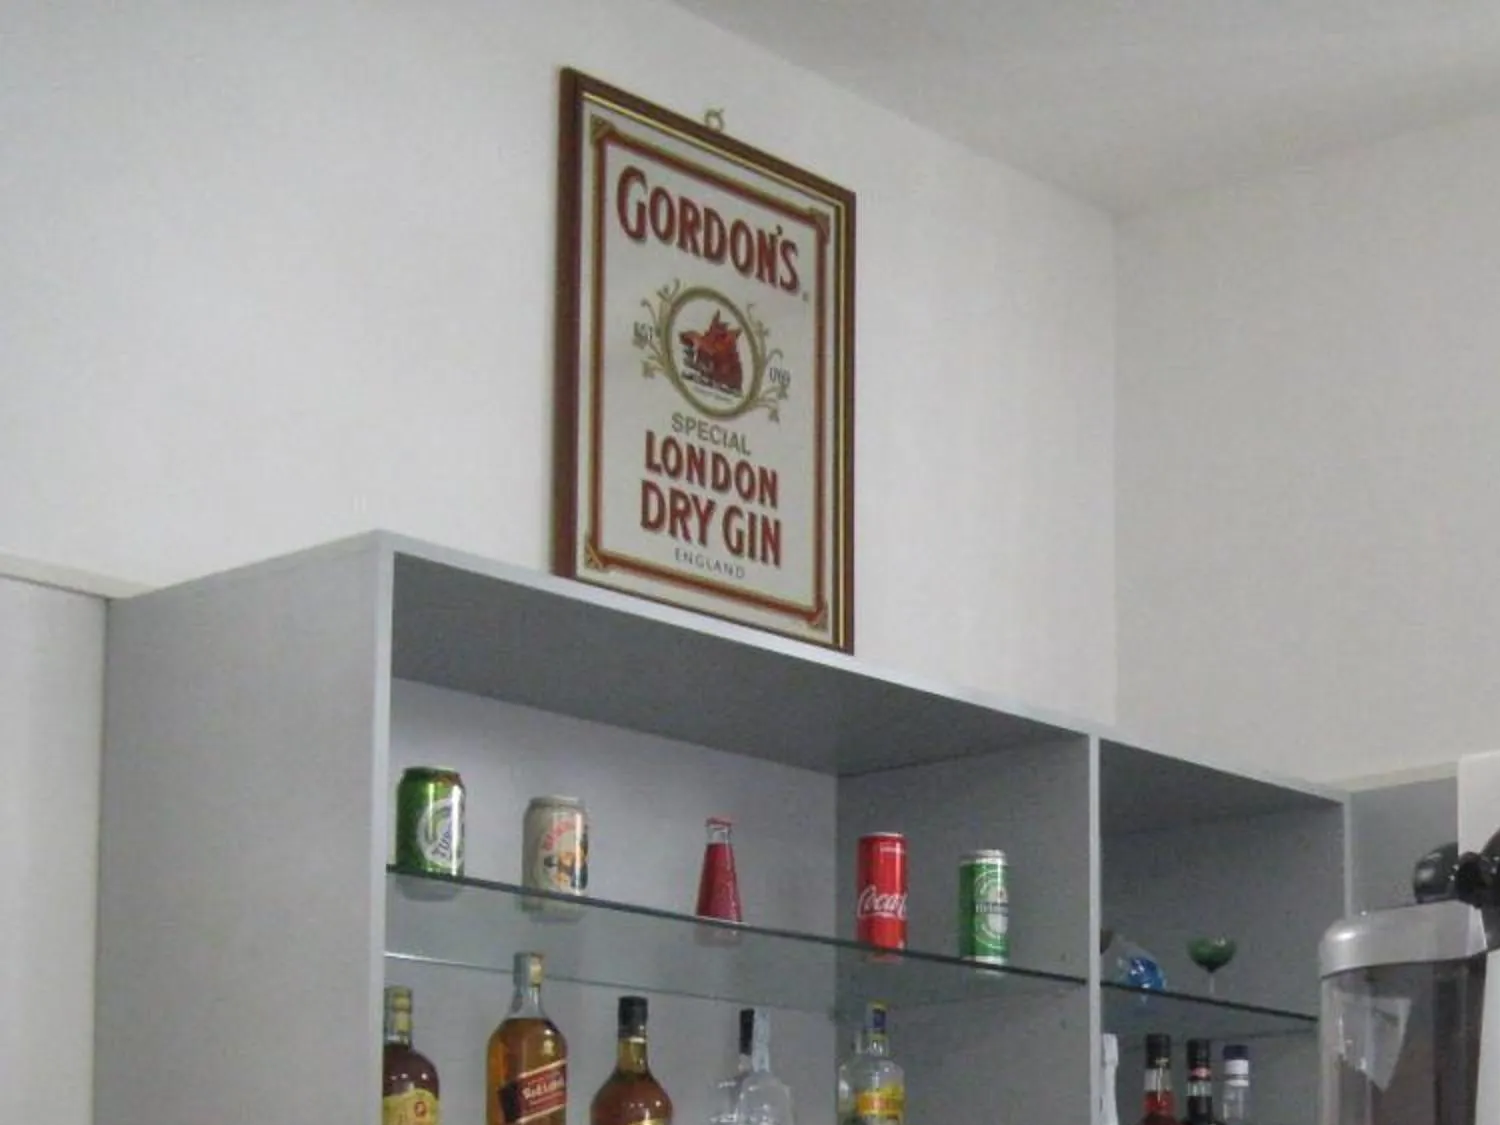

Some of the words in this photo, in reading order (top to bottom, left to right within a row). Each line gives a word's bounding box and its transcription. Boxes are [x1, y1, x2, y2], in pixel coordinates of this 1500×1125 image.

[617, 165, 800, 294] GORDON'S
[645, 430, 779, 509] LONDON
[671, 412, 752, 456] SPECIAL
[640, 479, 717, 548] DRY
[721, 504, 782, 570] GIN
[674, 548, 746, 580] ENGLAND
